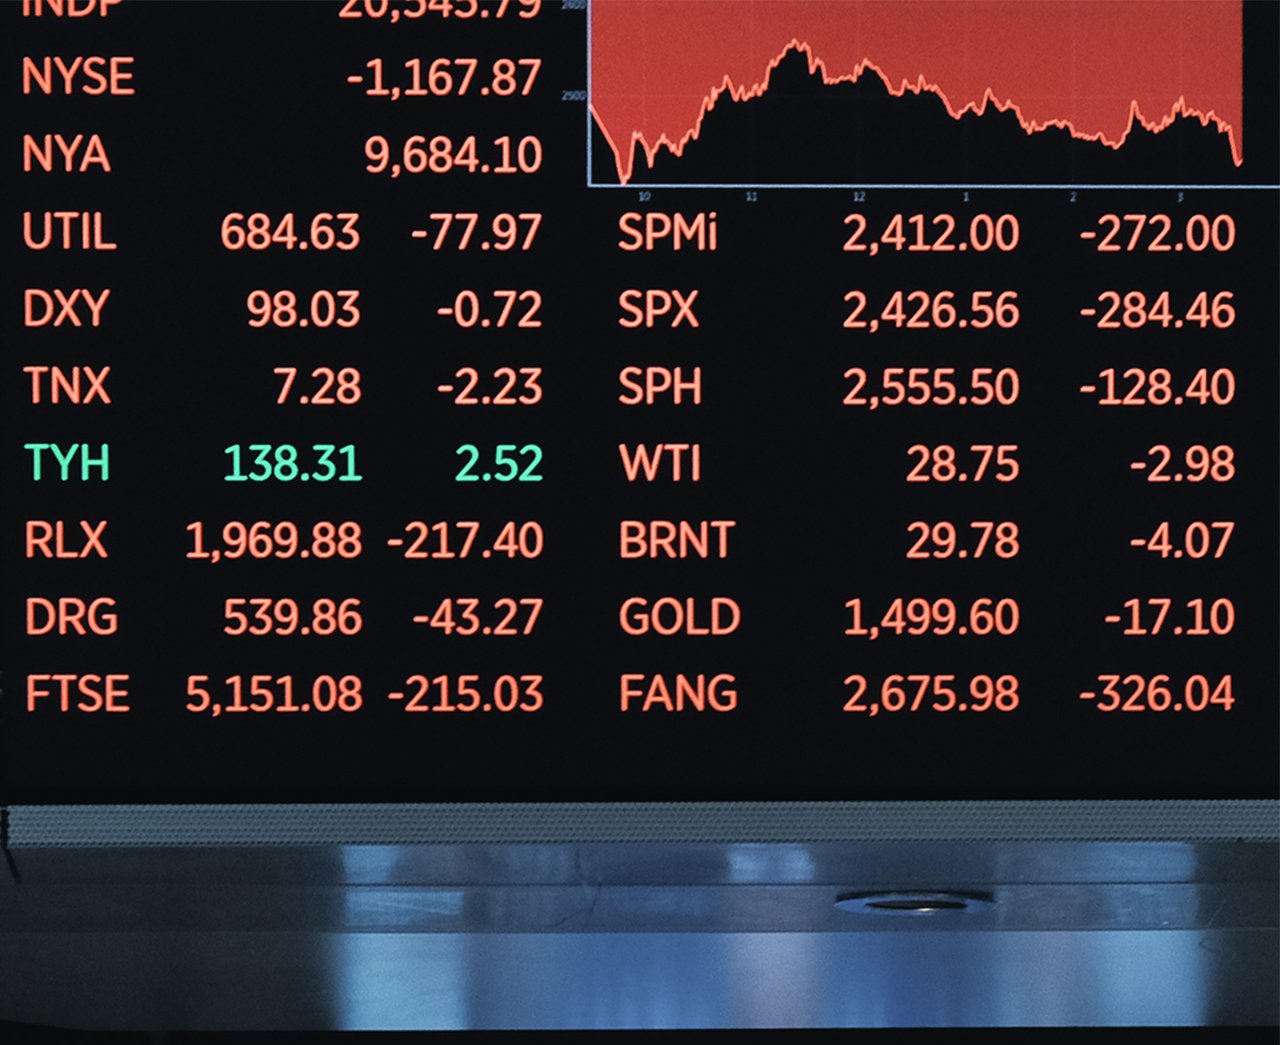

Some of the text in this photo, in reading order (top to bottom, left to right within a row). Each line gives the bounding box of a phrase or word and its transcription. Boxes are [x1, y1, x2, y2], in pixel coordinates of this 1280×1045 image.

[23, 56, 541, 100] NYSE -1,167.87
[24, 134, 542, 178] NYA 9,684.10
[24, 212, 542, 250] UTIL 684.63 -77.97
[619, 212, 1235, 256] SPMi 2,412.00 -272.00
[25, 289, 542, 327] DXY 98.03 -0.72
[619, 289, 1235, 333] SPX 2,426.56 -284.46
[23, 366, 542, 404] TNX 7.28 -2.23
[619, 367, 1235, 410] SPH 2,555.50 -128.40
[24, 444, 543, 481] TYH 138.31 2.52
[619, 444, 1235, 482] WTI 28.75 -2.98
[26, 521, 543, 563] RLX 1,969.88 -217.40
[621, 521, 1235, 558] BRNT 29.78 -4.07
[27, 597, 543, 635] DRG 539.86 -43.27
[620, 597, 1235, 640] GOLD 1,499.60 -17.10
[27, 674, 543, 716] FTSE 5,151.08 -215.03
[621, 674, 1235, 716] FANG 2,675.98 -326.04
